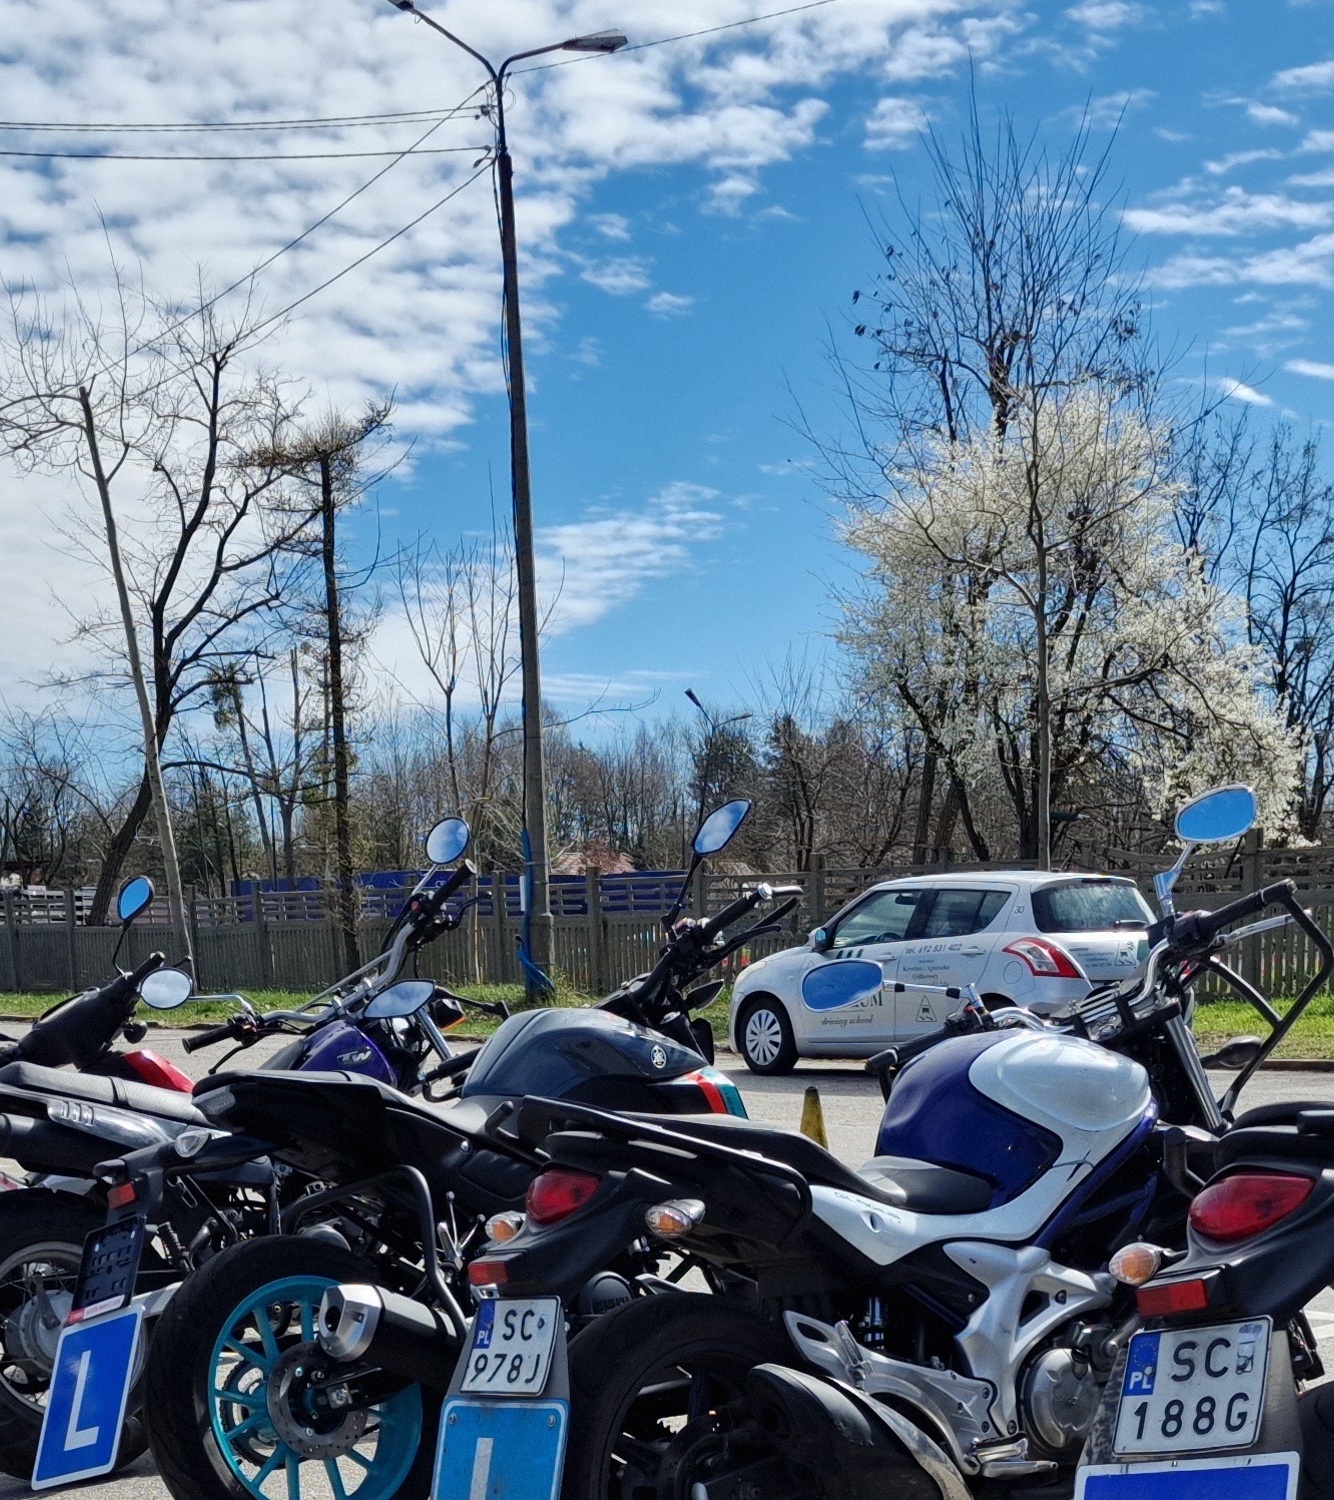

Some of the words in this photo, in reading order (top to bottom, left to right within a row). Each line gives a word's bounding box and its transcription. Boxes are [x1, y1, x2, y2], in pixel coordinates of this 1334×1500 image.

[336, 1050, 372, 1063] TW
[476, 1330, 490, 1345] PL
[502, 1309, 536, 1341] SC
[469, 1353, 541, 1384] 978J
[1171, 1337, 1231, 1383] SC
[1129, 1371, 1152, 1391] PL
[63, 1350, 100, 1452] L
[1133, 1392, 1250, 1440] 188G
